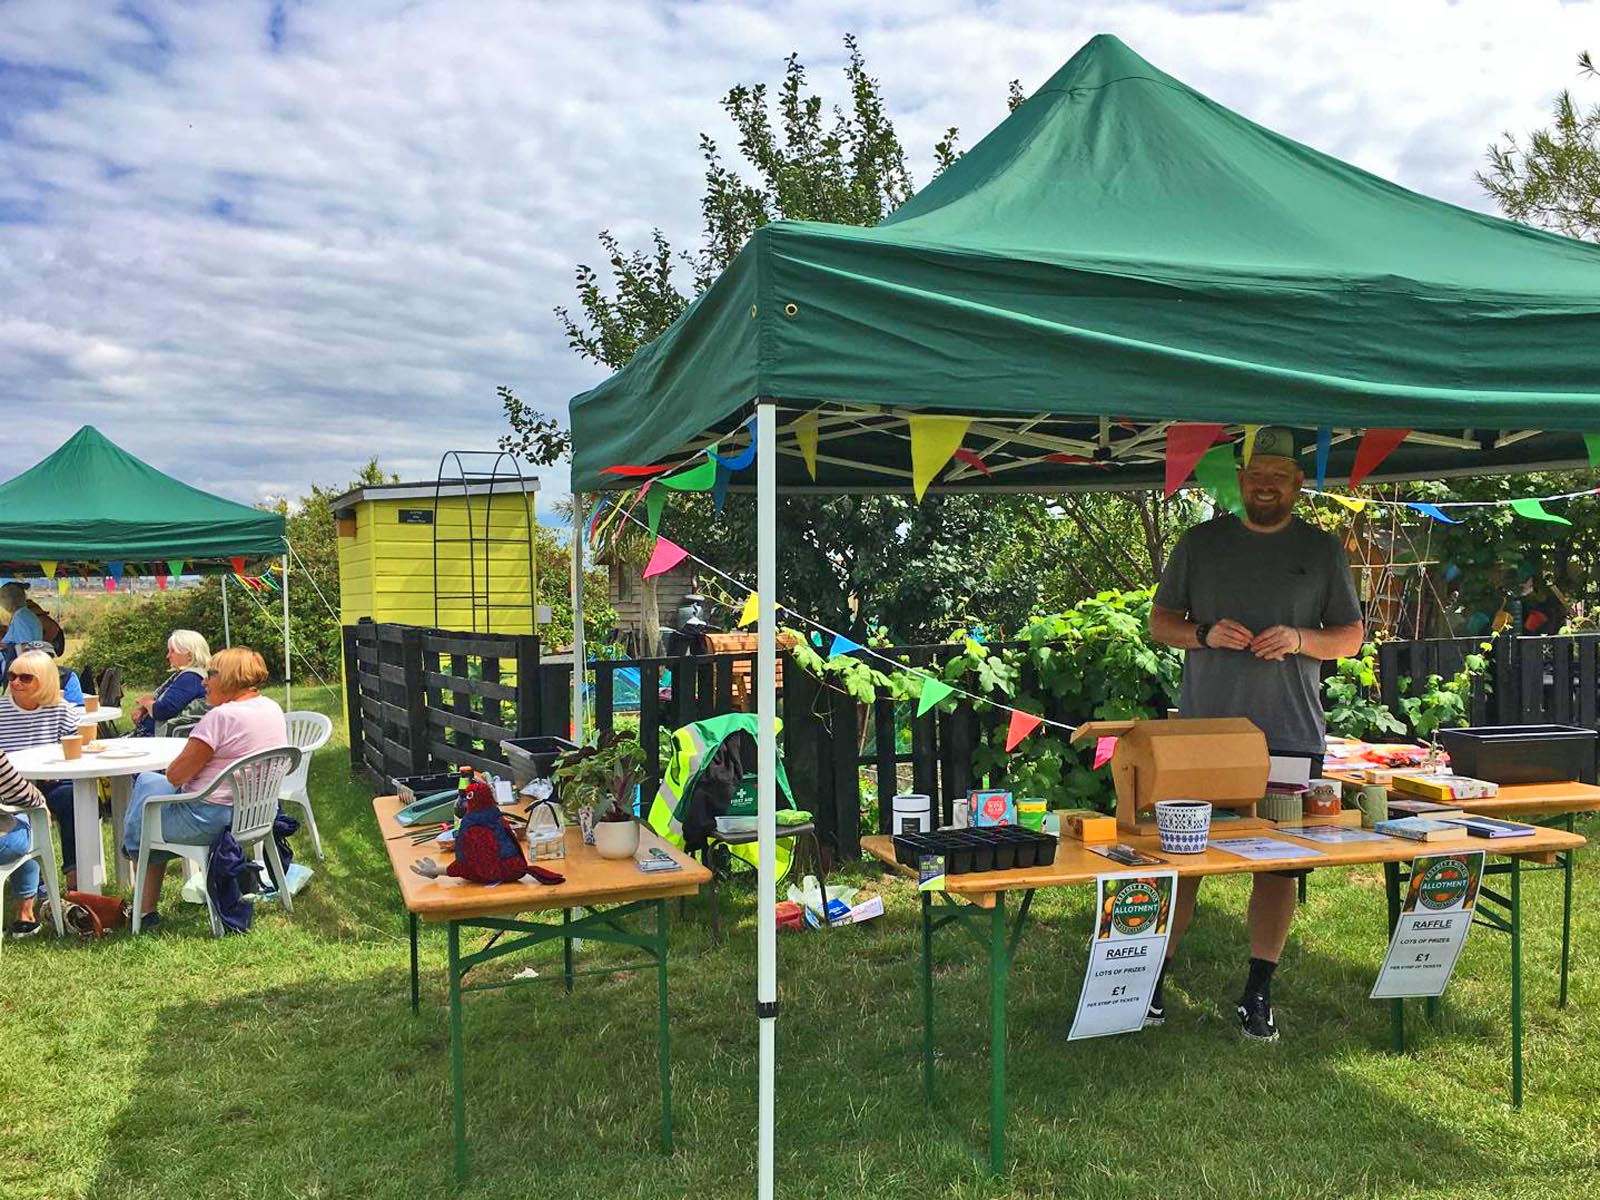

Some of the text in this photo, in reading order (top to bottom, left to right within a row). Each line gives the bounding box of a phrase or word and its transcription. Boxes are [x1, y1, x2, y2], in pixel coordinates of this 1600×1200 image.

[1422, 879, 1467, 890] ALLOTMENT
[1114, 904, 1158, 914] ALLOTMENT
[1412, 919, 1453, 929] RAFFLE
[1106, 945, 1148, 958] RAFFLE
[1415, 953, 1430, 962] £1
[1123, 966, 1146, 974] PRIZES
[1112, 985, 1127, 996] £1
